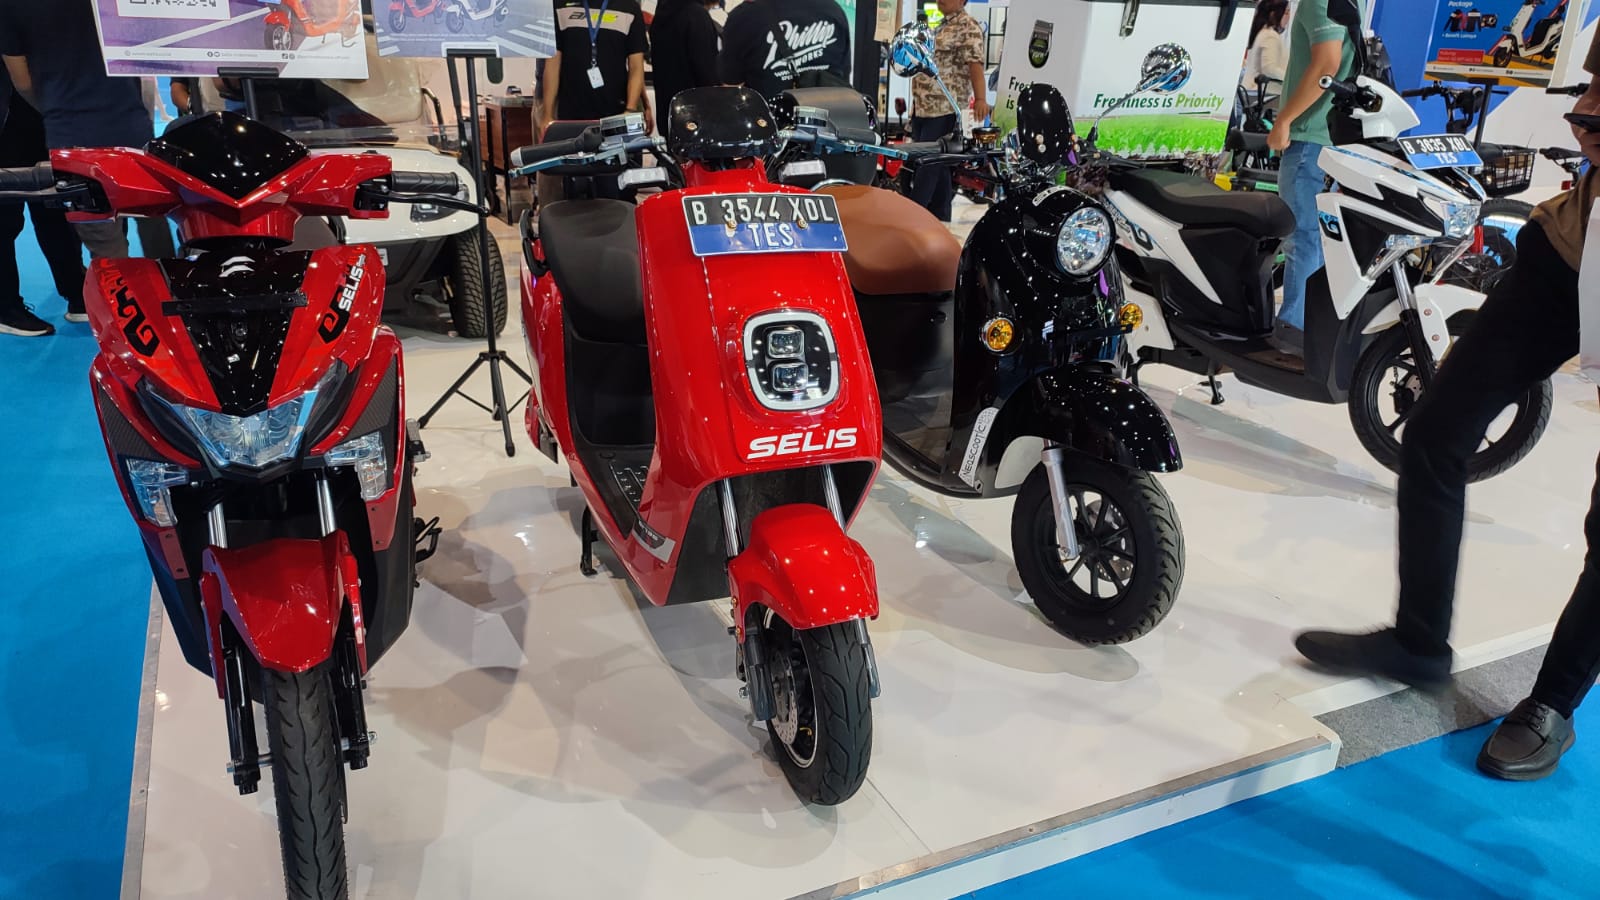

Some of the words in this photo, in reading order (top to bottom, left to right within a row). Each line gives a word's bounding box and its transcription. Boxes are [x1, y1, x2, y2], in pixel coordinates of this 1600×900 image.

[794, 48, 823, 66] WORKS
[1006, 94, 1014, 110] is
[1162, 94, 1173, 108] is
[1175, 93, 1223, 111] Priority
[1402, 141, 1416, 155] B
[691, 201, 708, 225] B
[721, 197, 781, 223] 3544
[788, 197, 834, 222] XDL
[748, 222, 794, 247] TES
[338, 265, 364, 312] SELIS
[747, 427, 858, 459] SELIS
